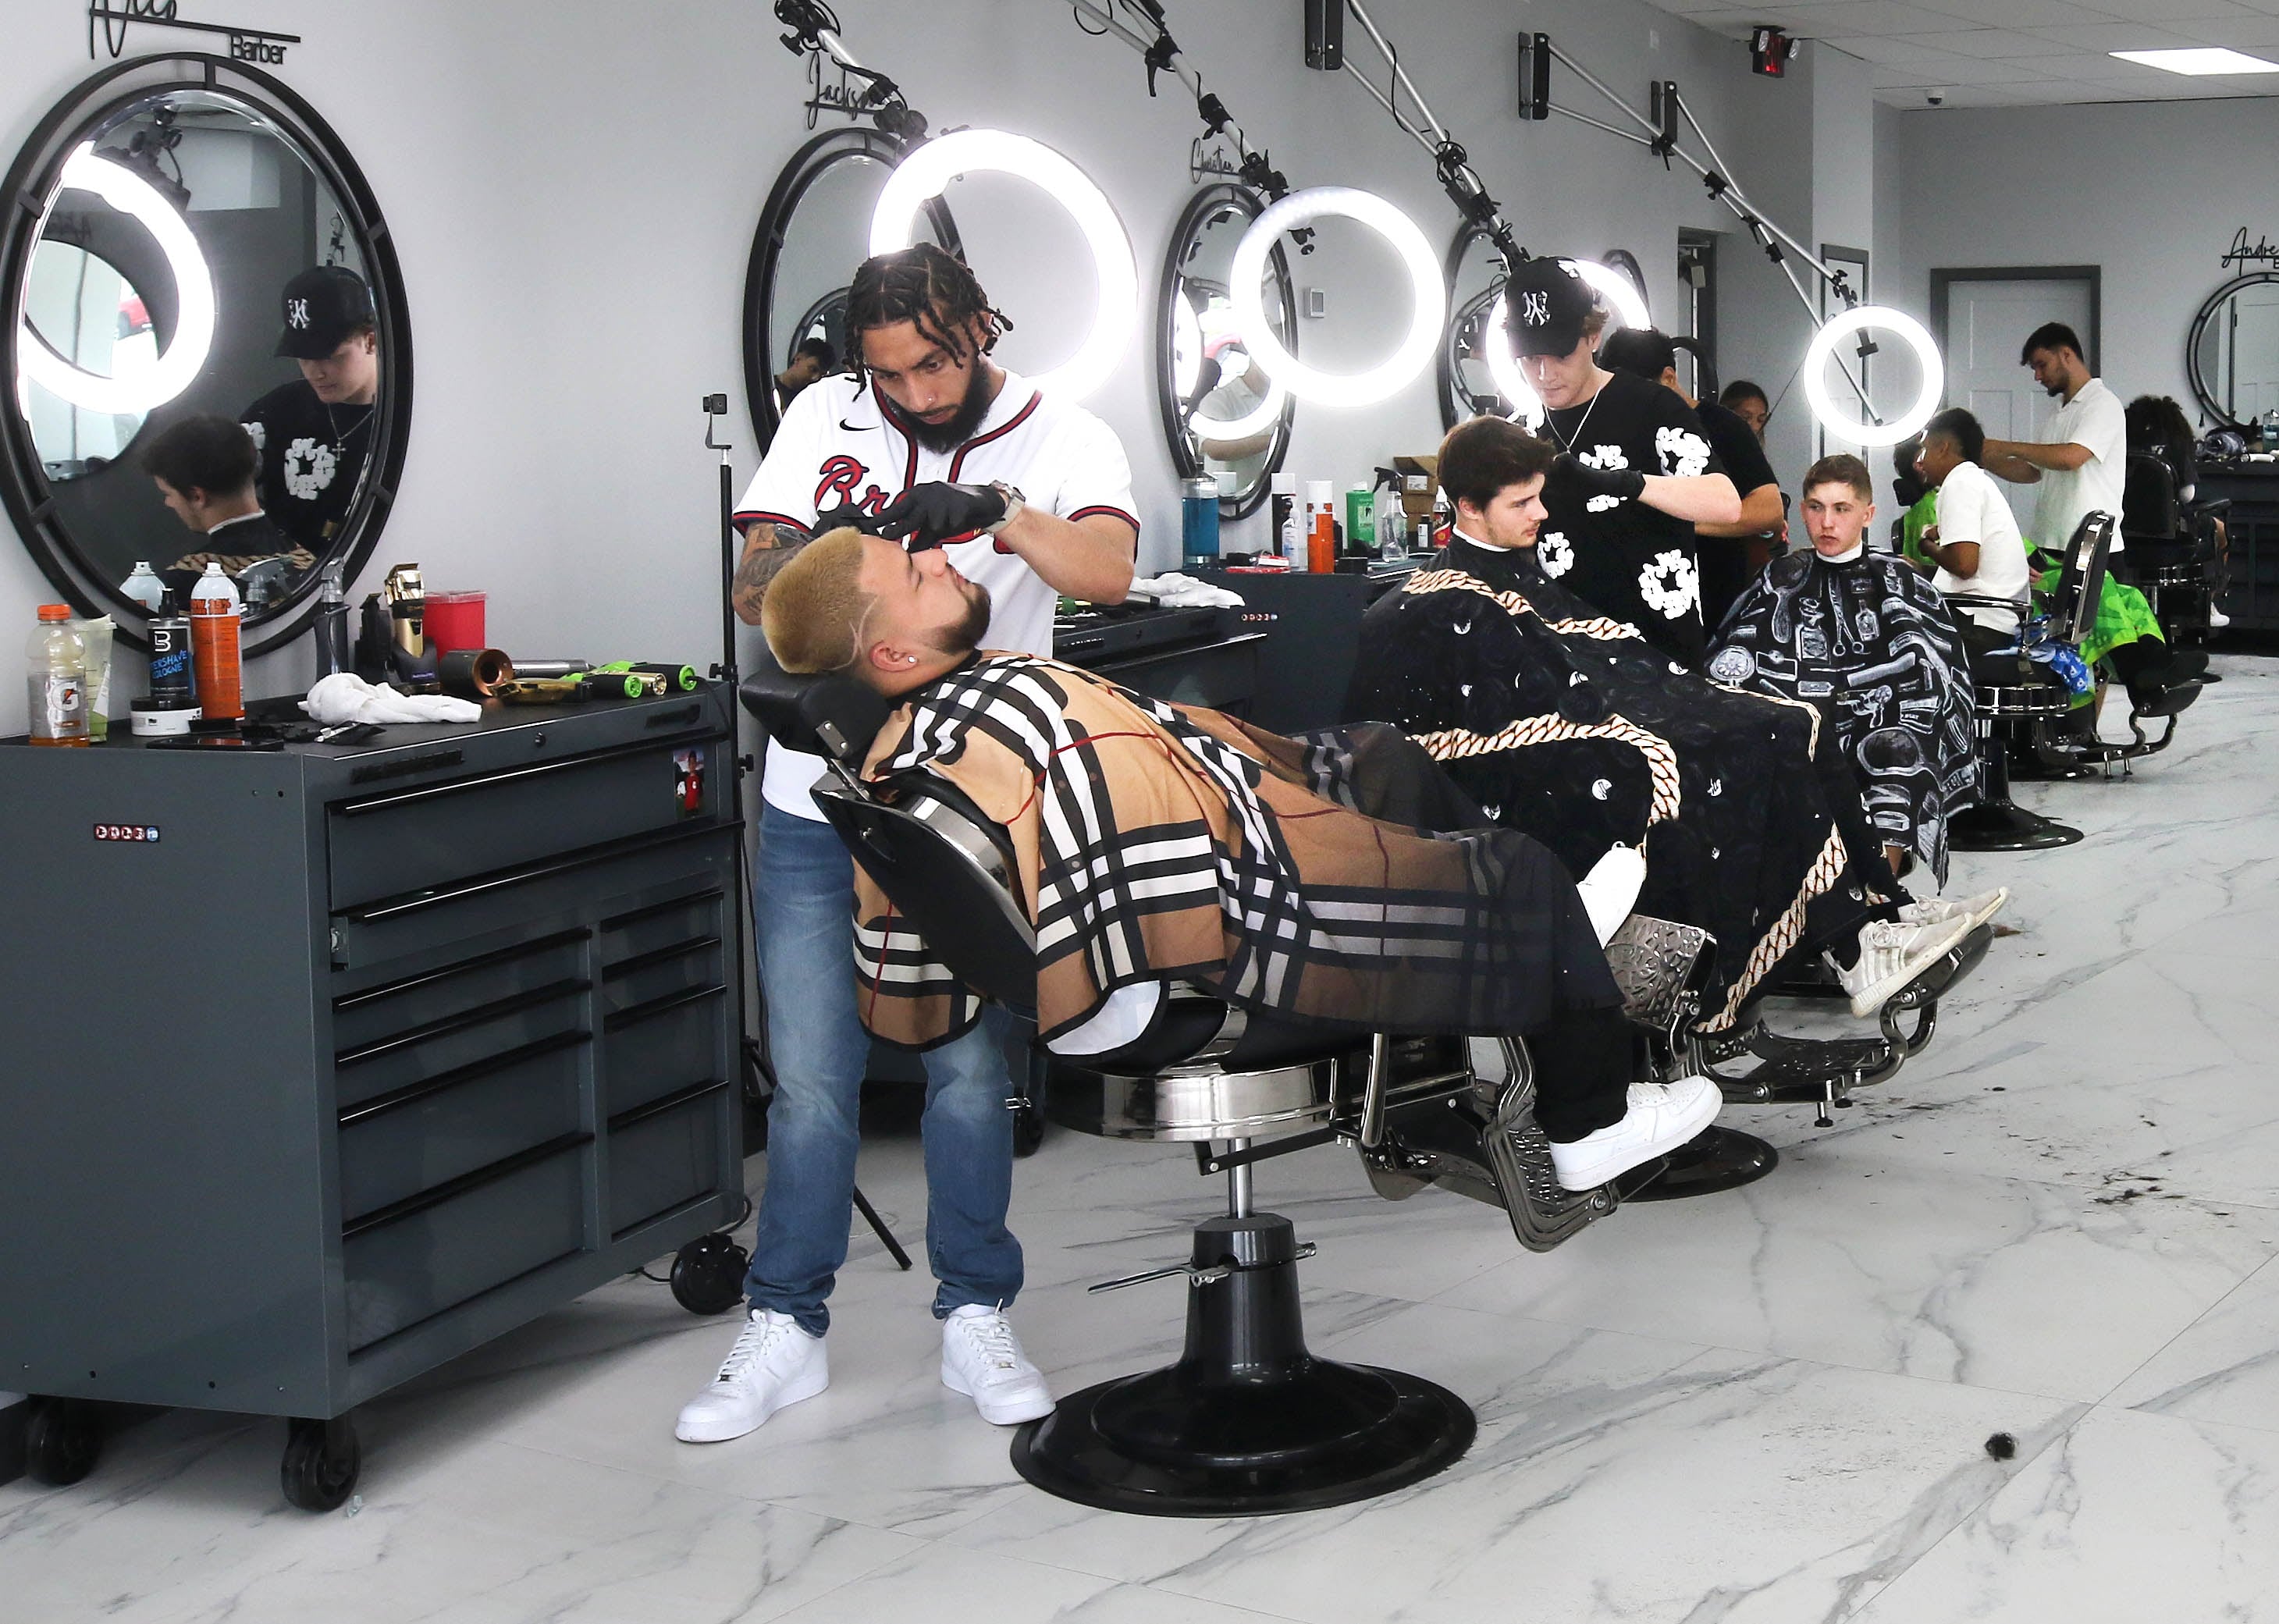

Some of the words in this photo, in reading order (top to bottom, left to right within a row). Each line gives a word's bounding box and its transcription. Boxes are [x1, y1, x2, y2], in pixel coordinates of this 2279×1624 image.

[230, 35, 286, 65] Barber
[807, 50, 873, 130] Jackso
[1522, 290, 1551, 326] NY
